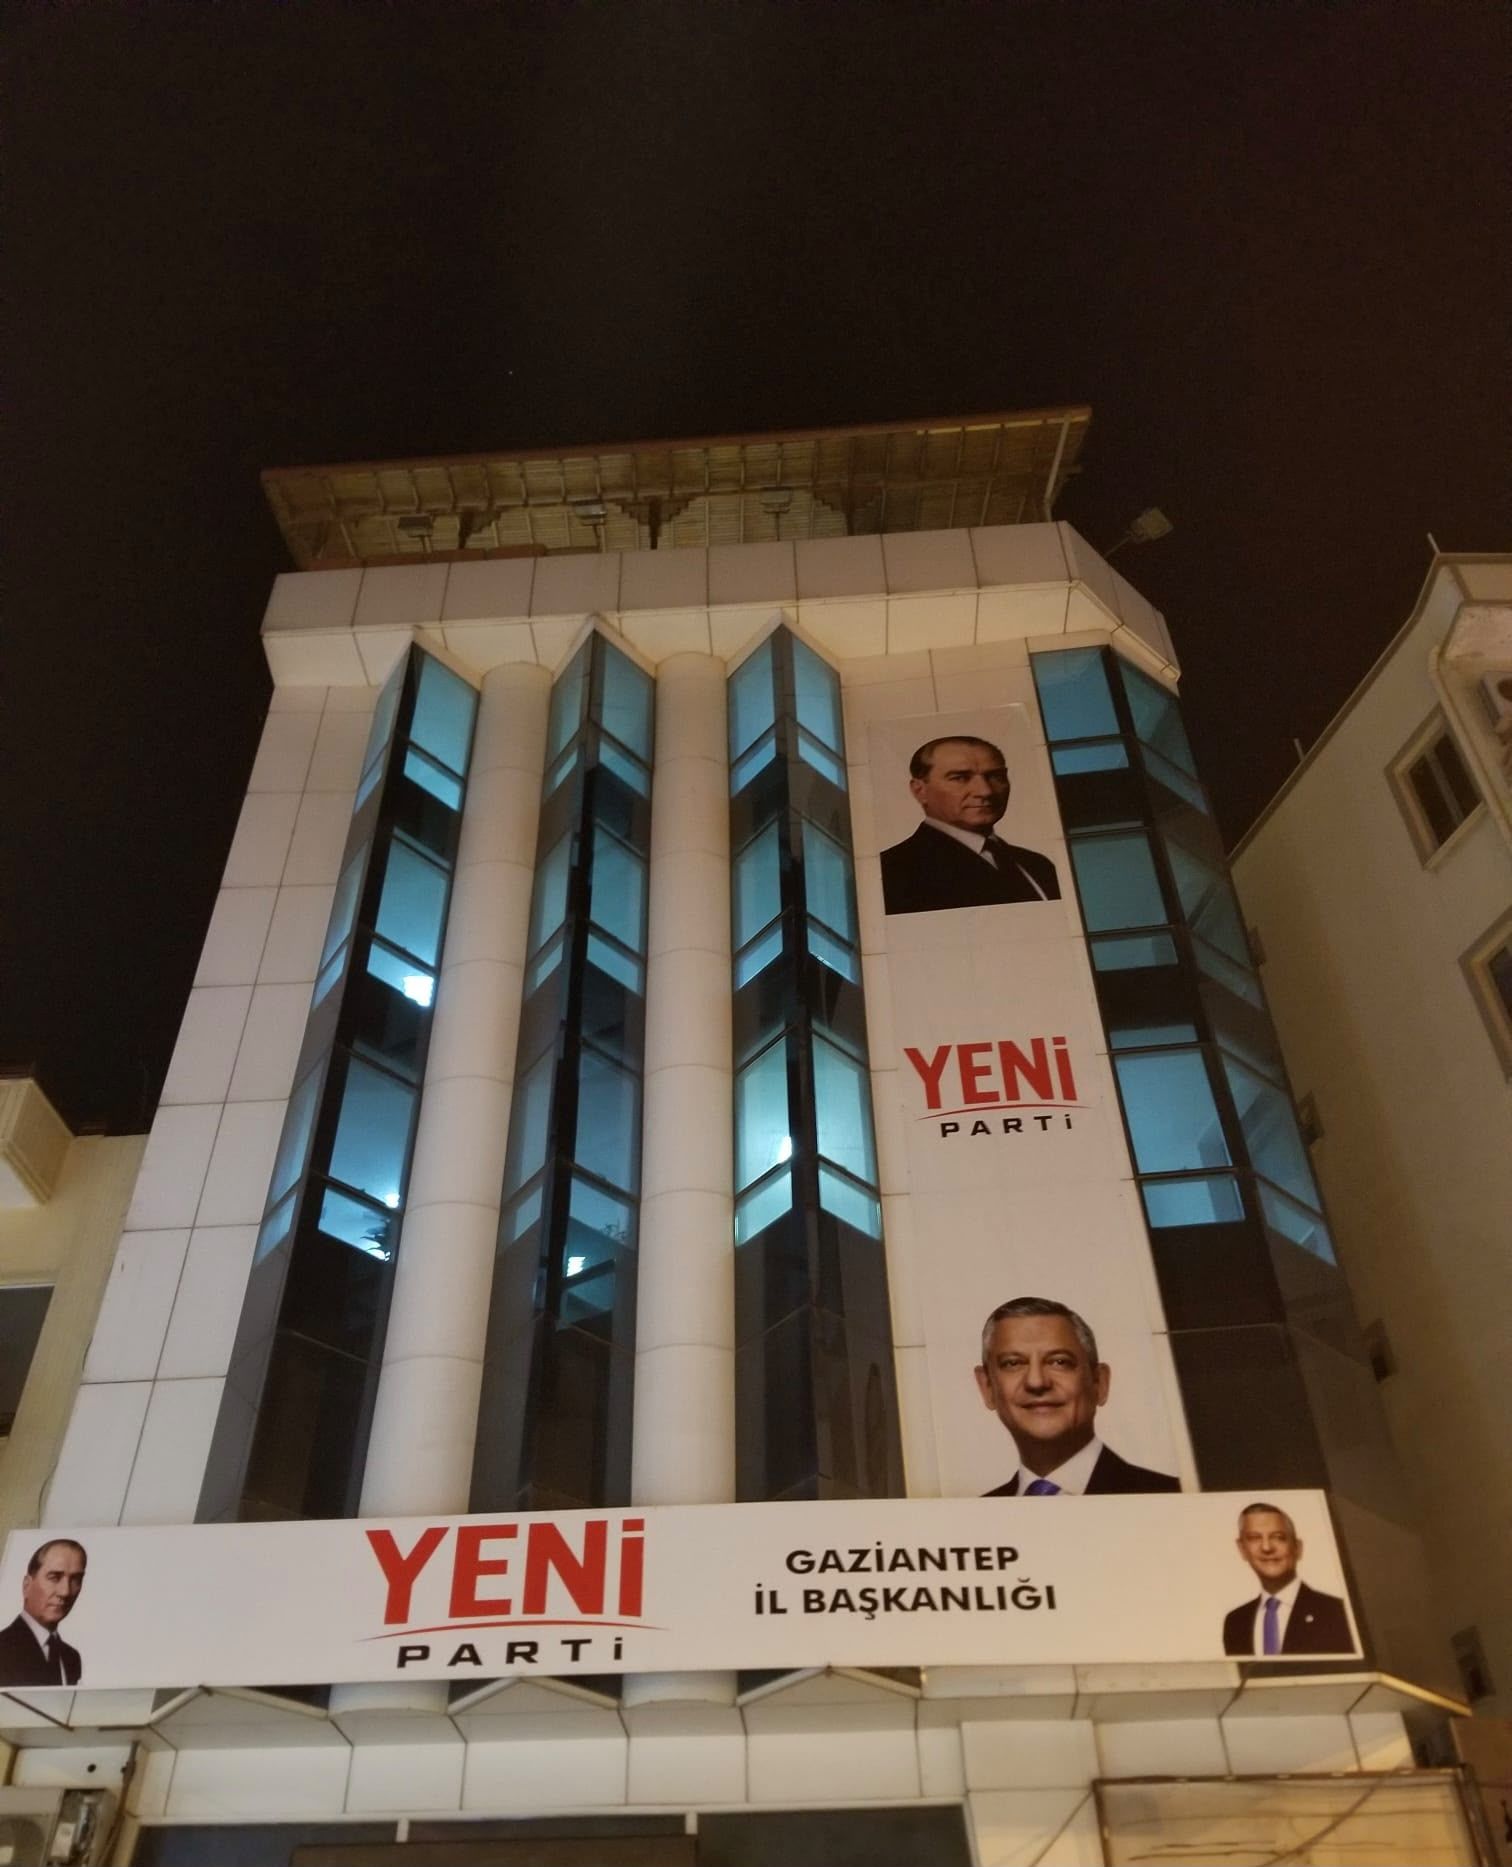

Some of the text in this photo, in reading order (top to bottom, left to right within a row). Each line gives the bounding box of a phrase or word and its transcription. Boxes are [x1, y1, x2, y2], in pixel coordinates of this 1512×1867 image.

[785, 1540, 1019, 1575] GAZİANTEP
[755, 1577, 1057, 1620] İL BAŞKANLIĞI
